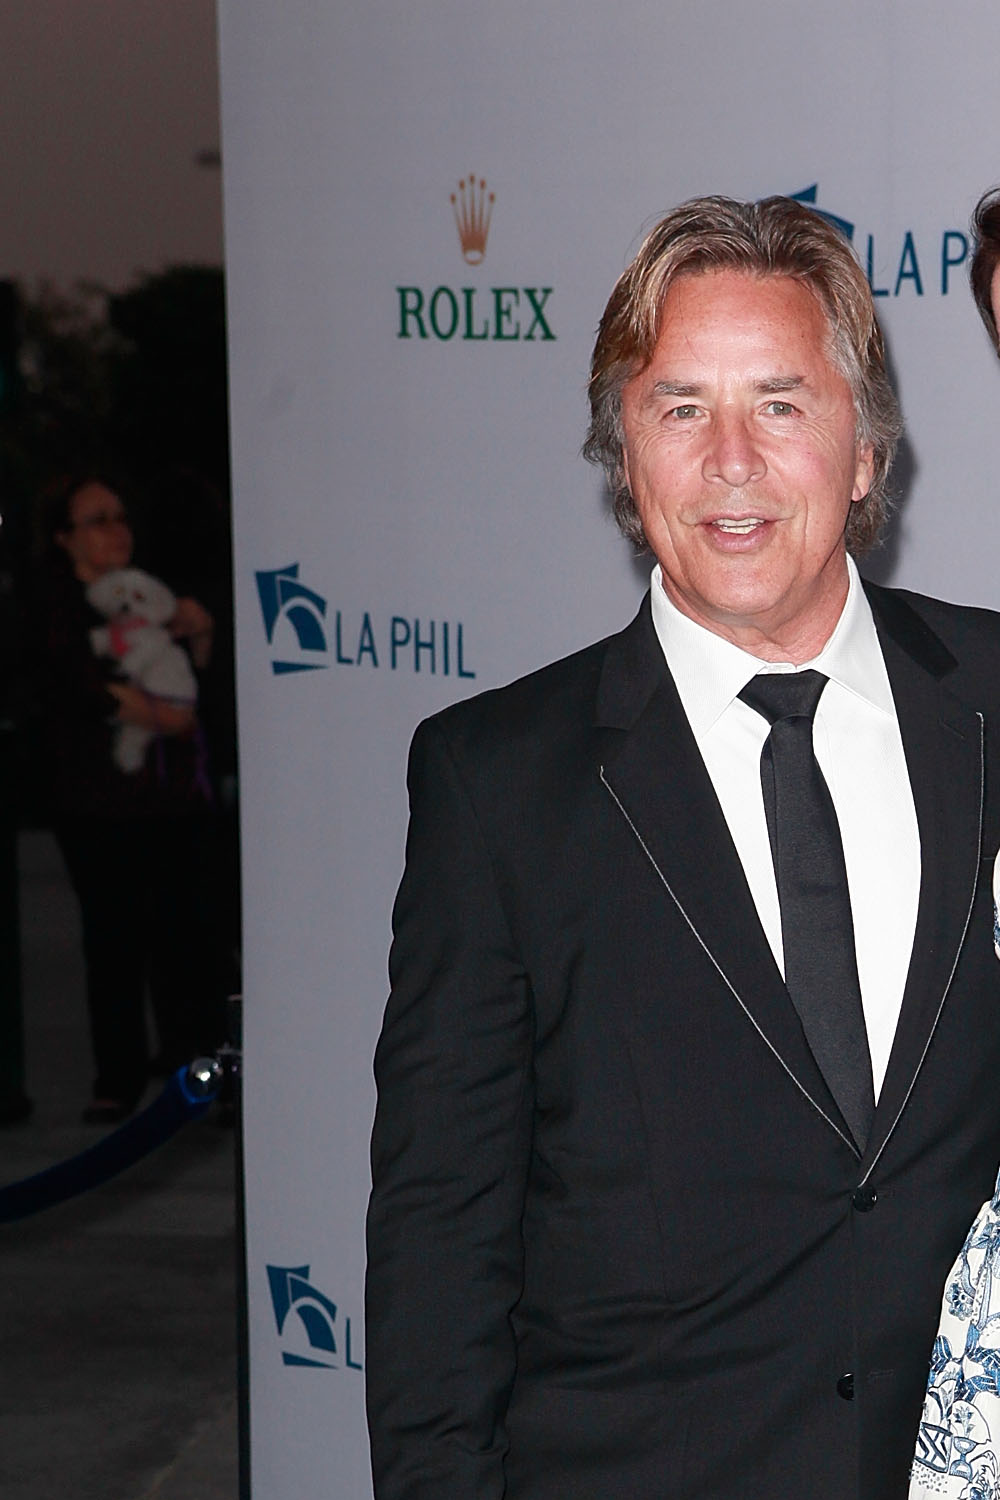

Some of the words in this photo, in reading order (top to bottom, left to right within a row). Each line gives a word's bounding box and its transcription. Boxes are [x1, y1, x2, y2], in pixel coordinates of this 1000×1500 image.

[866, 230, 924, 298] LA
[396, 285, 557, 342] ROLEX
[335, 611, 379, 668] LA
[391, 616, 476, 679] PHIL
